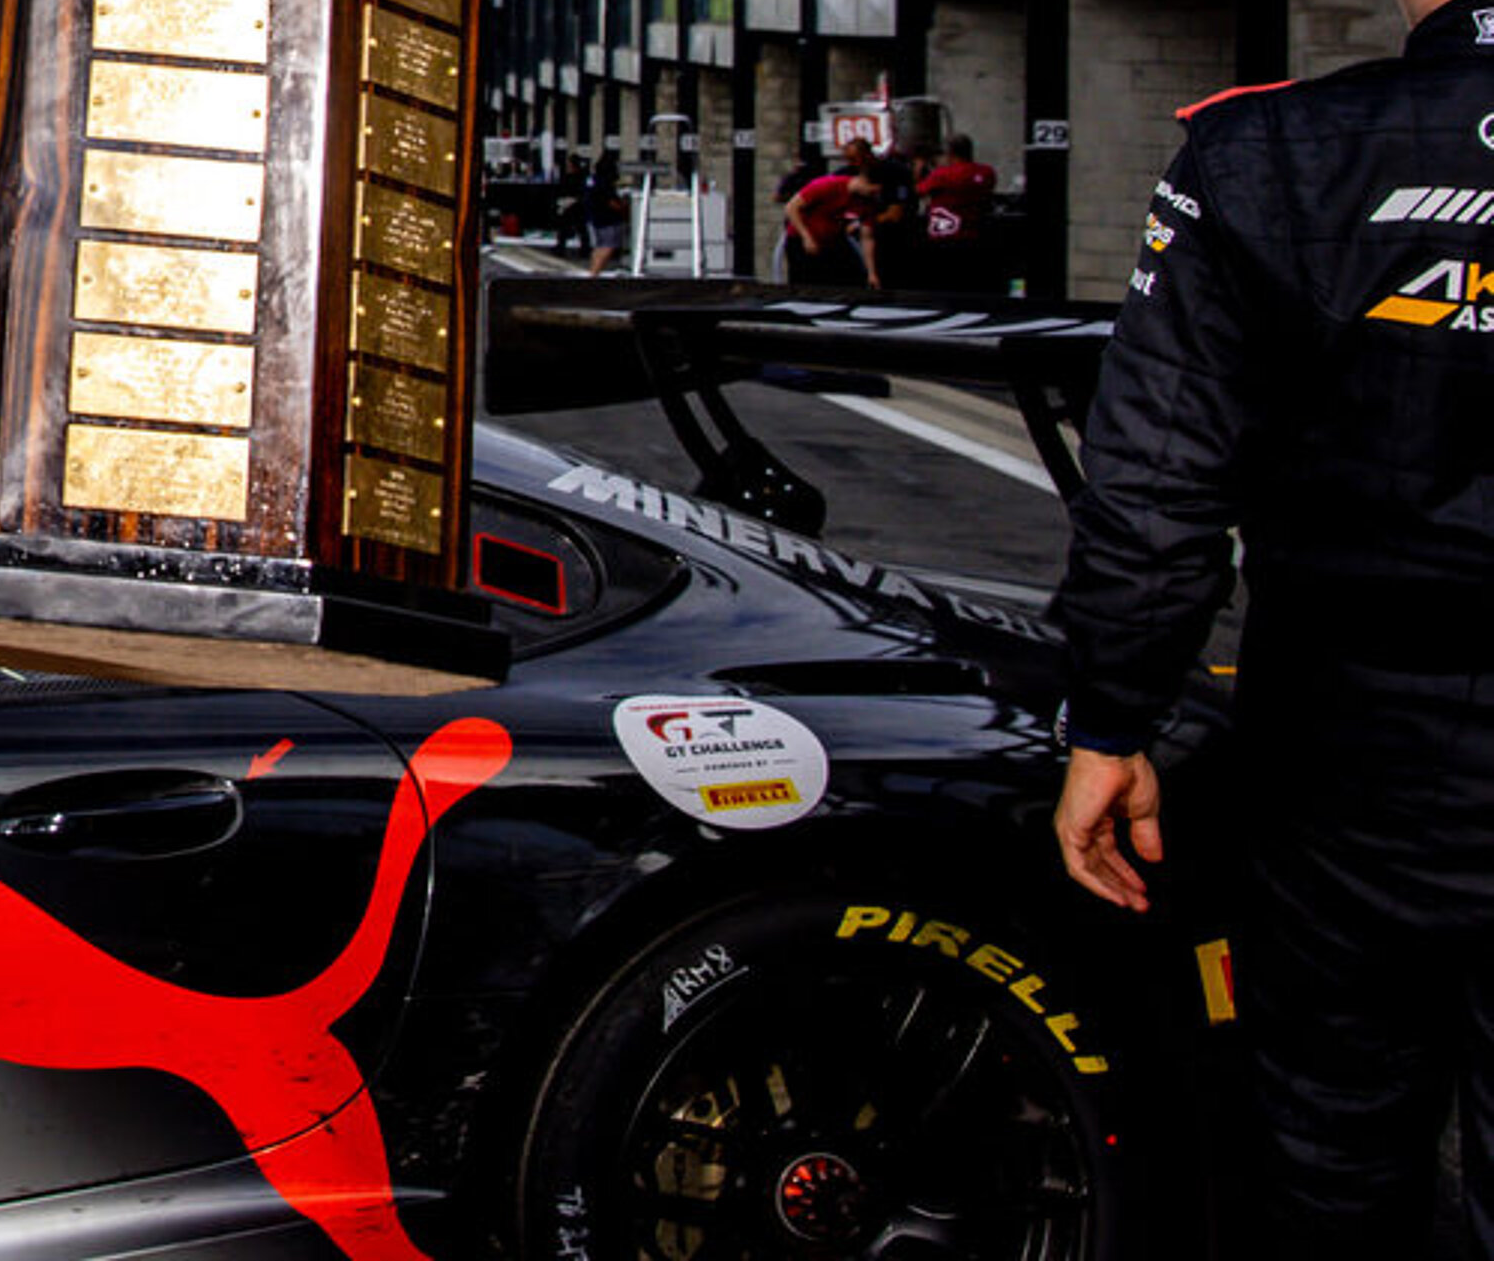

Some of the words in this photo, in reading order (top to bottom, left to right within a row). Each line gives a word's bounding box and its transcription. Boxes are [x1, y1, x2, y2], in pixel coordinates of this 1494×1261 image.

[547, 463, 935, 608] MINERVA
[690, 738, 785, 756] CHALLENGE
[709, 782, 791, 808] PIRELLI
[835, 905, 1109, 1074] PIRELLI
